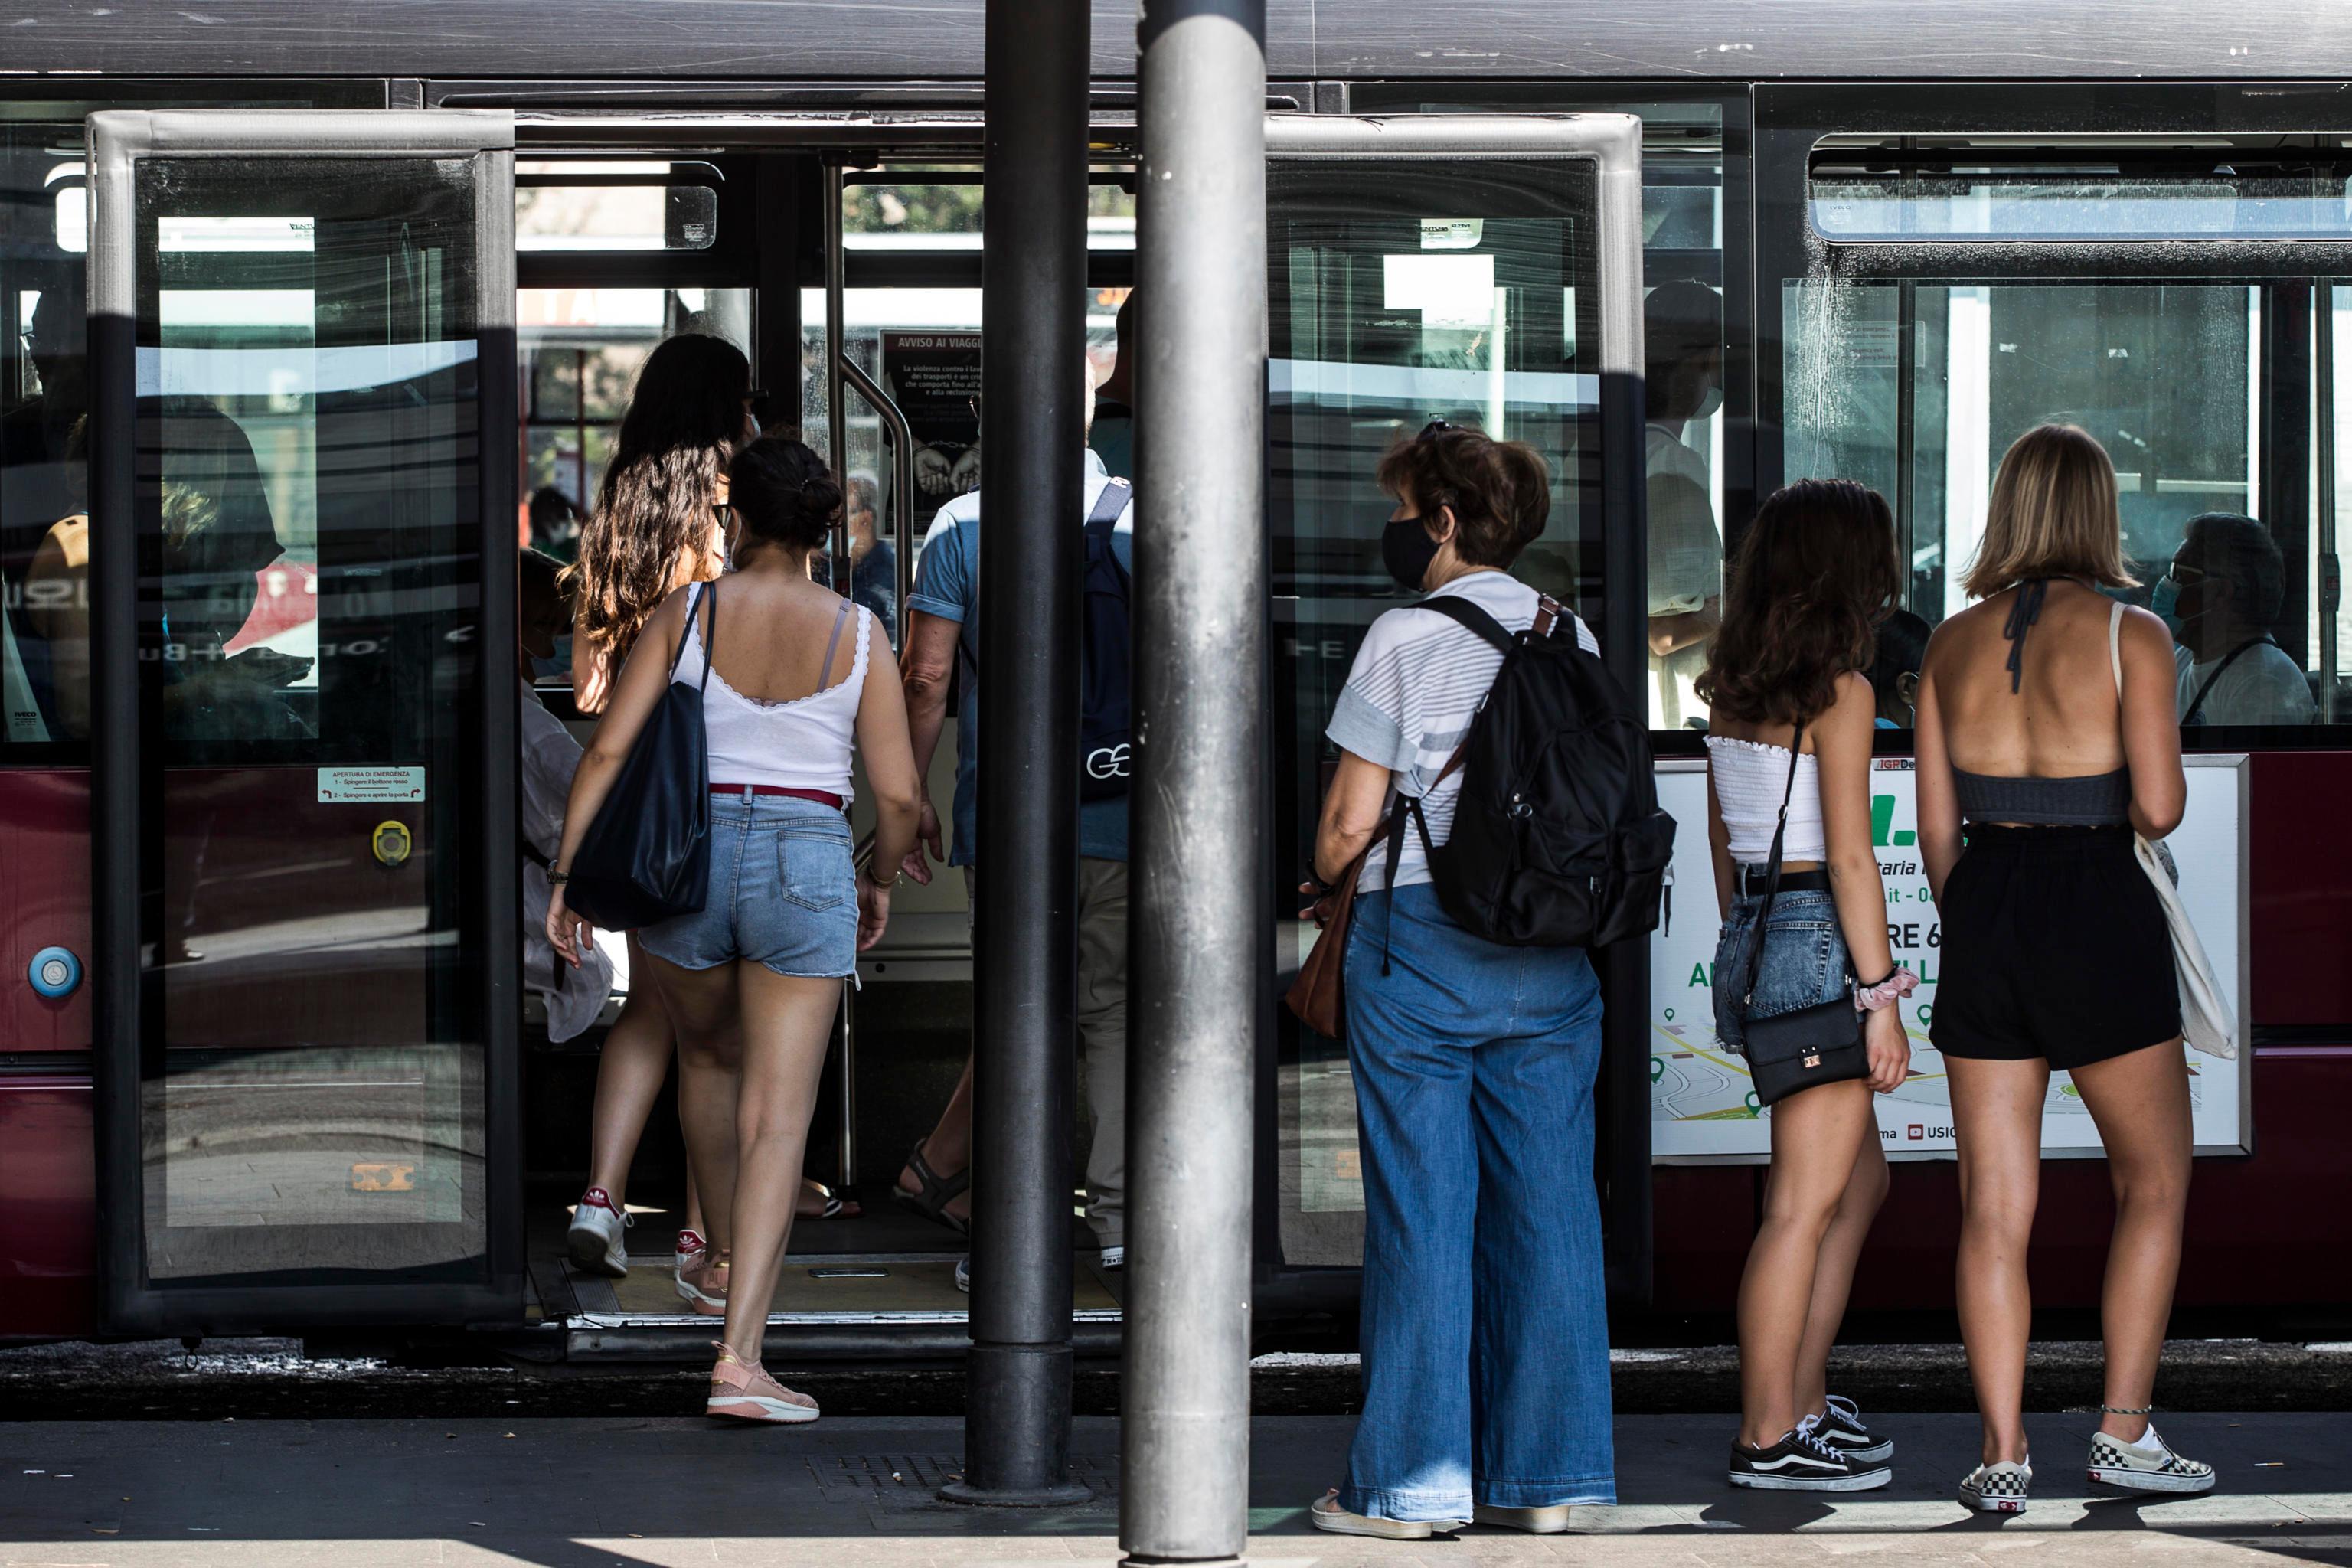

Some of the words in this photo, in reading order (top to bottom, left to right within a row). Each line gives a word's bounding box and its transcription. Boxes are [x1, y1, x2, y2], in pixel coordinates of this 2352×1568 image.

[898, 338, 933, 348] AVVISO
[936, 338, 946, 348] AI
[949, 338, 981, 348] VIAGGI
[923, 373, 952, 382] trasporti
